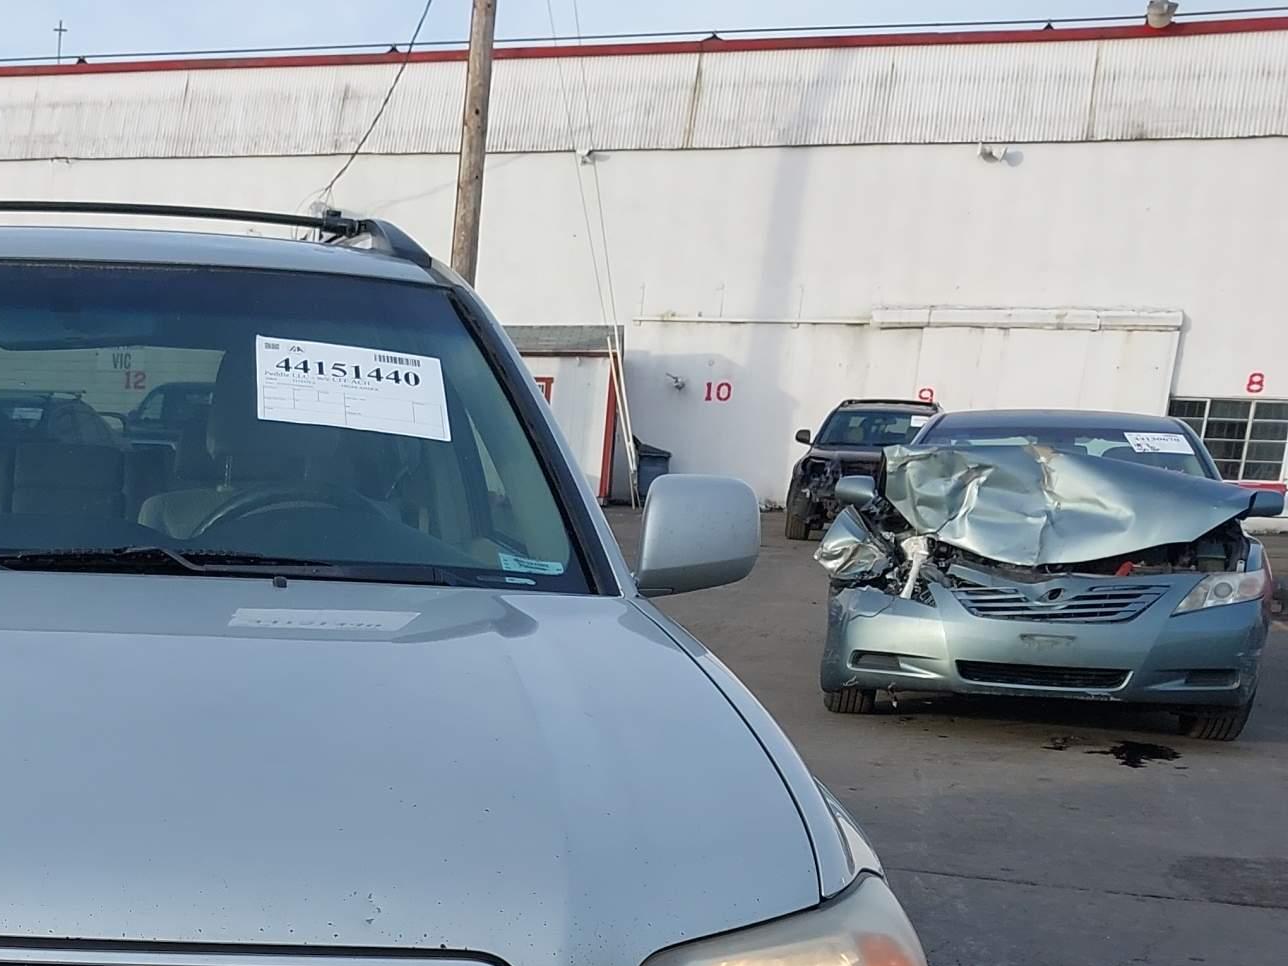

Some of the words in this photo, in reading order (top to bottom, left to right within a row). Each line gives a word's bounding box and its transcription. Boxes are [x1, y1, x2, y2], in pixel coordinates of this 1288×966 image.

[112, 352, 132, 369] VIC
[124, 371, 146, 390] 12
[275, 357, 420, 387] 44151440
[704, 382, 732, 402] 10
[1246, 372, 1265, 393] 8
[918, 388, 934, 403] 9
